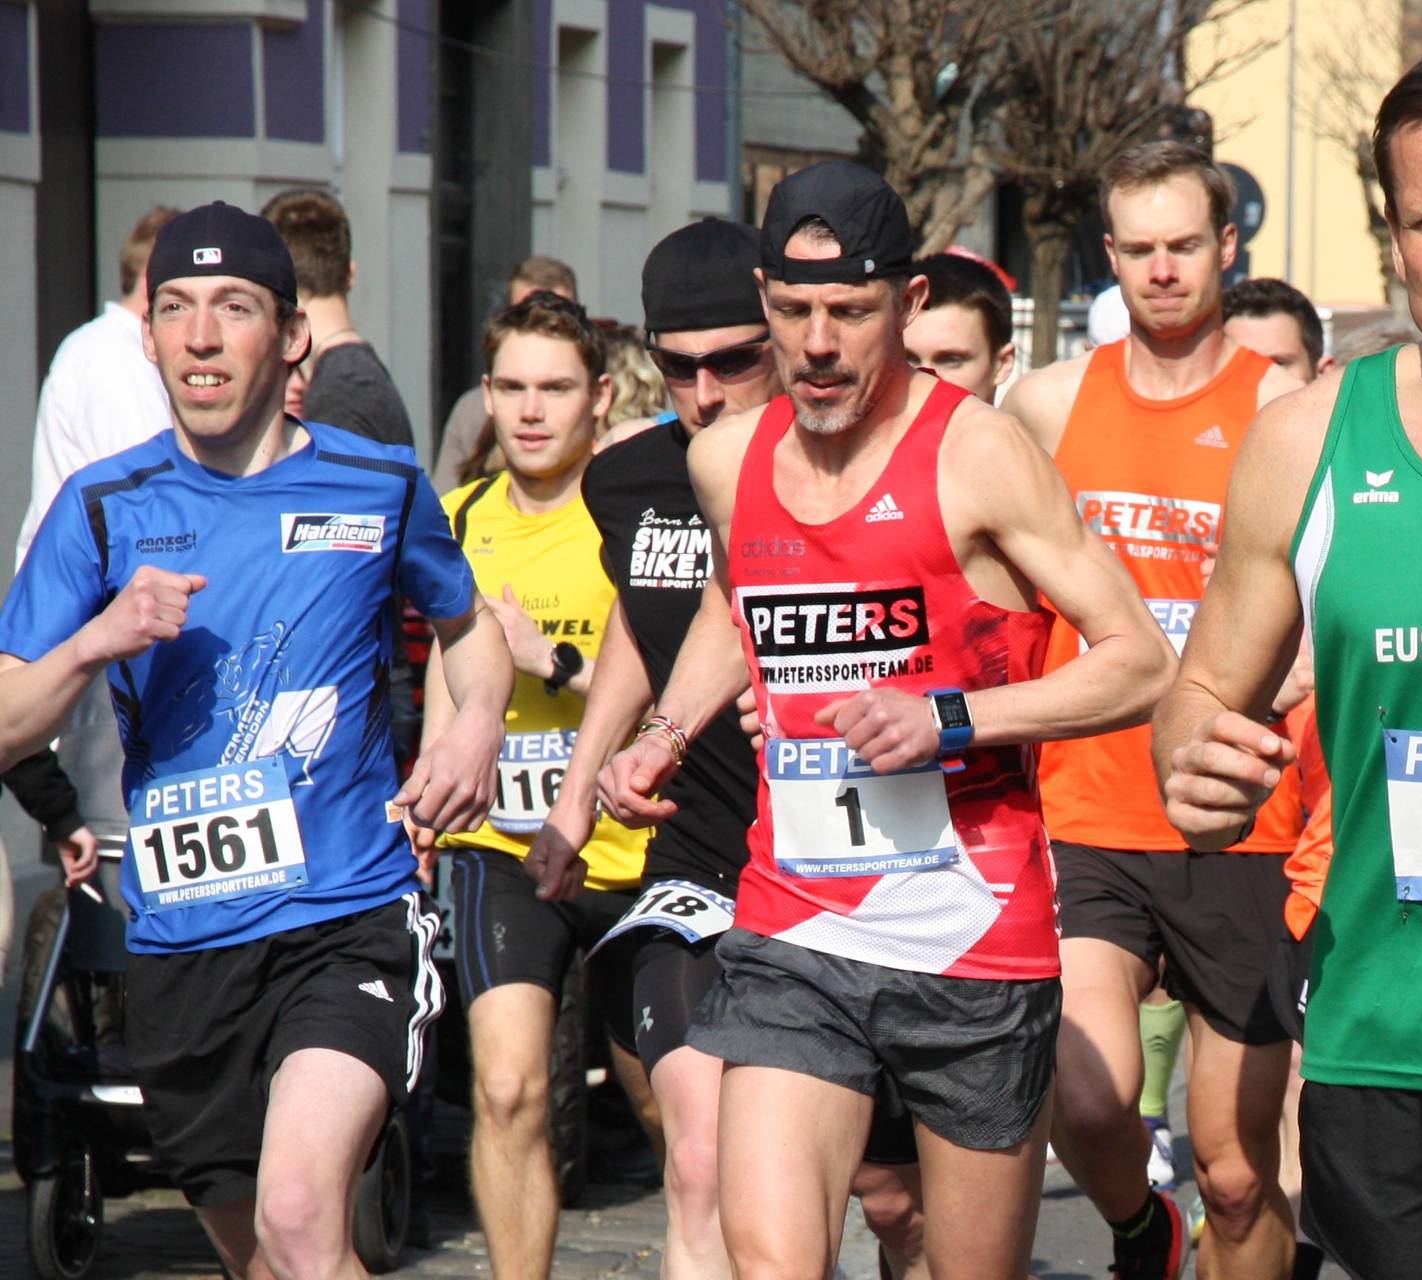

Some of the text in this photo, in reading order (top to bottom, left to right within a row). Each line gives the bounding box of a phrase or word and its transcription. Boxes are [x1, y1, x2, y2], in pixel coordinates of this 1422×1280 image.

[1353, 489, 1400, 504] erima
[639, 507, 683, 526] Born
[865, 508, 904, 523] adidas
[1083, 499, 1214, 540] PETERS
[293, 524, 381, 542] Harzheim
[632, 527, 712, 554] SWIM
[534, 619, 595, 636] WEL
[752, 599, 920, 646] PETERS
[777, 742, 900, 775] PETE
[145, 769, 265, 818] PETERS
[835, 787, 866, 847] 1
[144, 808, 280, 884] 1561
[796, 855, 940, 873] WWW.PETERSSPORTTEAM.DE
[158, 870, 286, 905] WWW.PETERSSPORTTEAM.DE
[619, 889, 709, 920] 18
